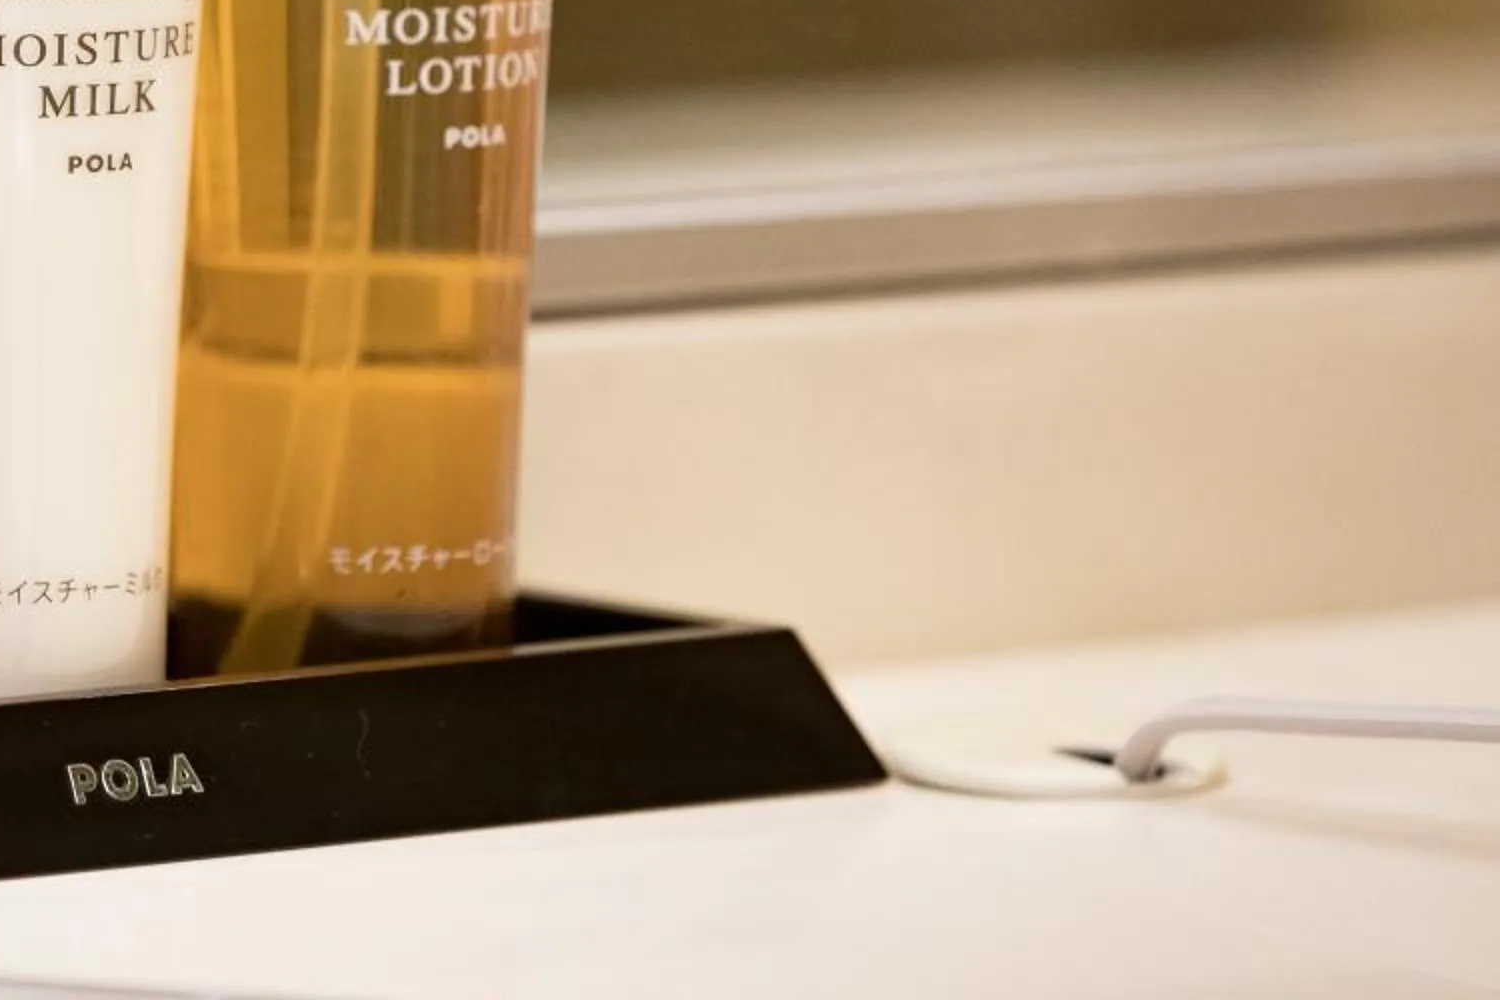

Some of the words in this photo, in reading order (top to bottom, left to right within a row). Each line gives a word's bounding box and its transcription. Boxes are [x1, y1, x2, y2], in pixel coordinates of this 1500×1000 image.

[37, 78, 157, 119] MILK
[443, 122, 508, 151] POLA
[67, 151, 134, 175] POLA
[66, 751, 205, 805] POLA
